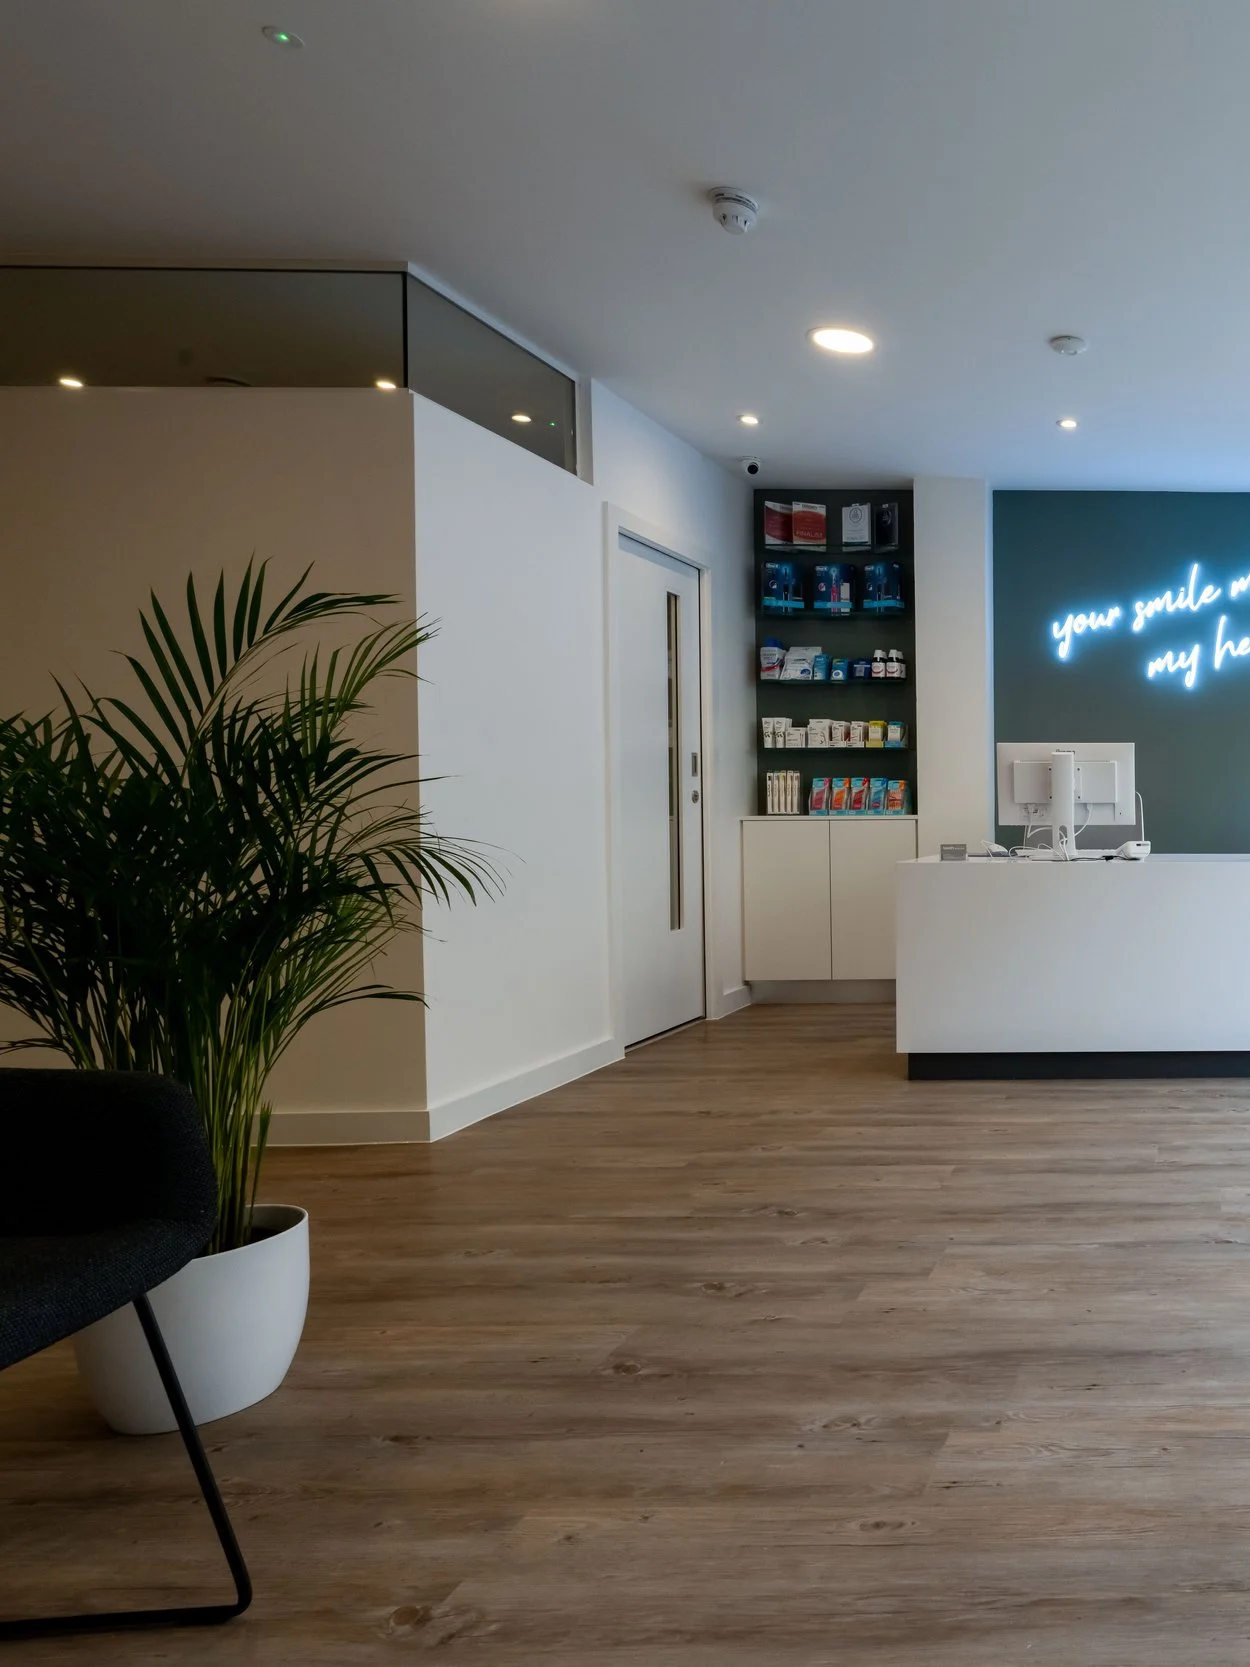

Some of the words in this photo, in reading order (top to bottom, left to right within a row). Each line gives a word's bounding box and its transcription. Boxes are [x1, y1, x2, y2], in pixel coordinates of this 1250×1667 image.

[1052, 602, 1121, 661] your
[1132, 562, 1222, 633] smile
[1147, 643, 1201, 690] my
